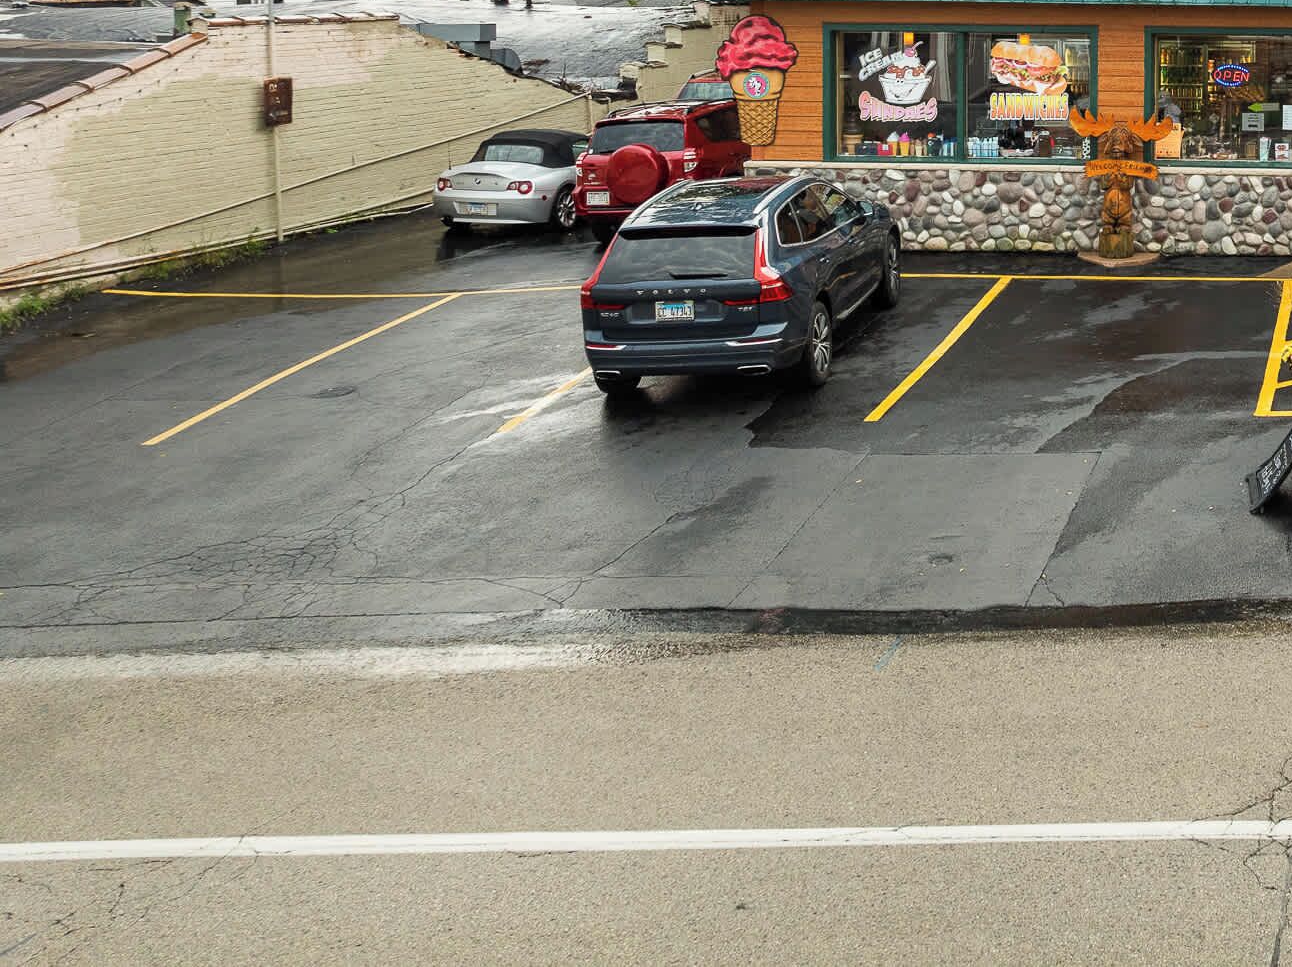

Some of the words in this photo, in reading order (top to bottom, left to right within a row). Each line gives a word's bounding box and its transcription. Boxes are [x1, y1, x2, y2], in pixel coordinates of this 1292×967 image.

[859, 48, 883, 67] ICE
[1213, 70, 1250, 82] OPEN
[859, 91, 938, 122] SUNDAES
[990, 92, 1069, 120] SANDWICHES
